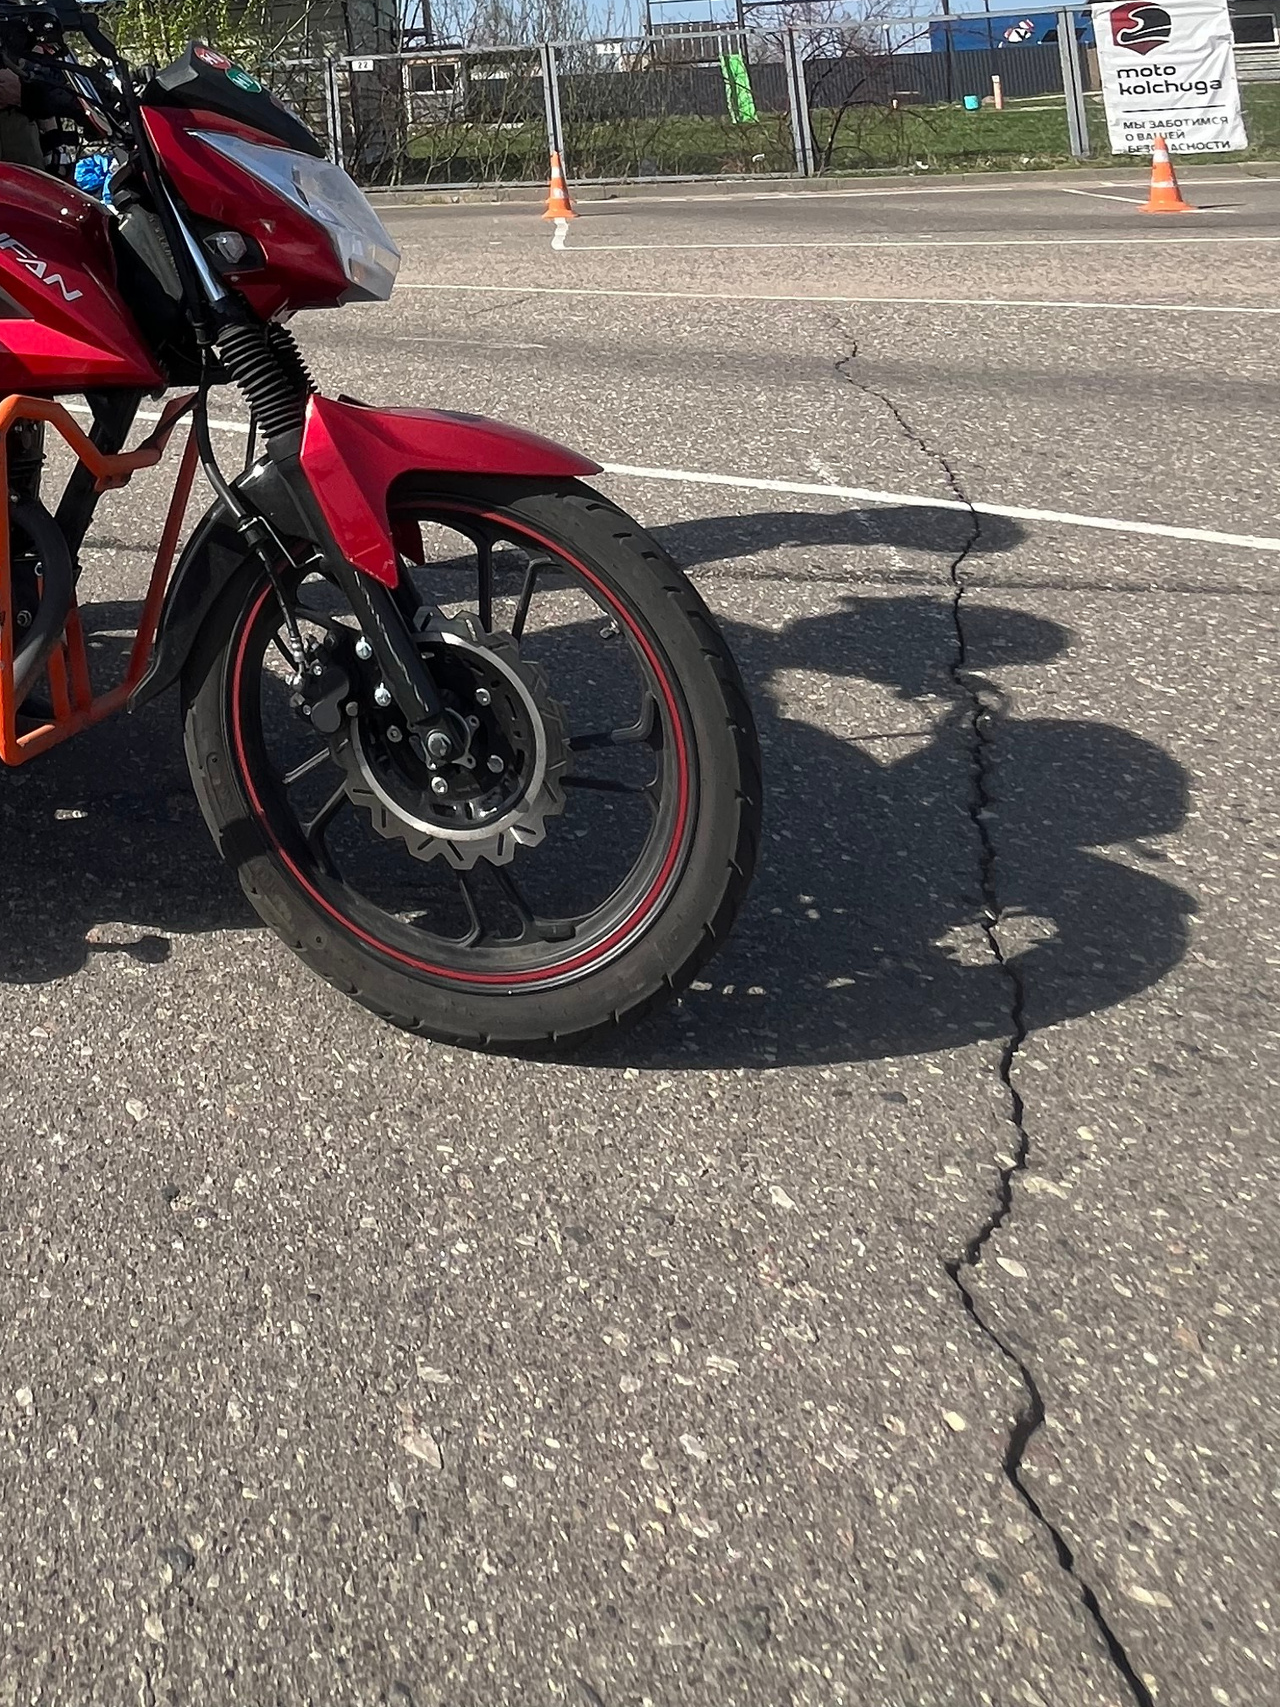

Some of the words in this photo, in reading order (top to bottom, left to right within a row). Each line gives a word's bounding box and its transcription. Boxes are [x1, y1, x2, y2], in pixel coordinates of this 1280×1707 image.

[1116, 64, 1176, 79] moto
[1119, 79, 1223, 96] kolchuga
[1123, 121, 1146, 130] МЫ
[1149, 116, 1229, 129] ЗАБОТИМСЯ
[1125, 133, 1134, 142] О
[1128, 140, 1231, 154] БЕЗАСНОСТИ
